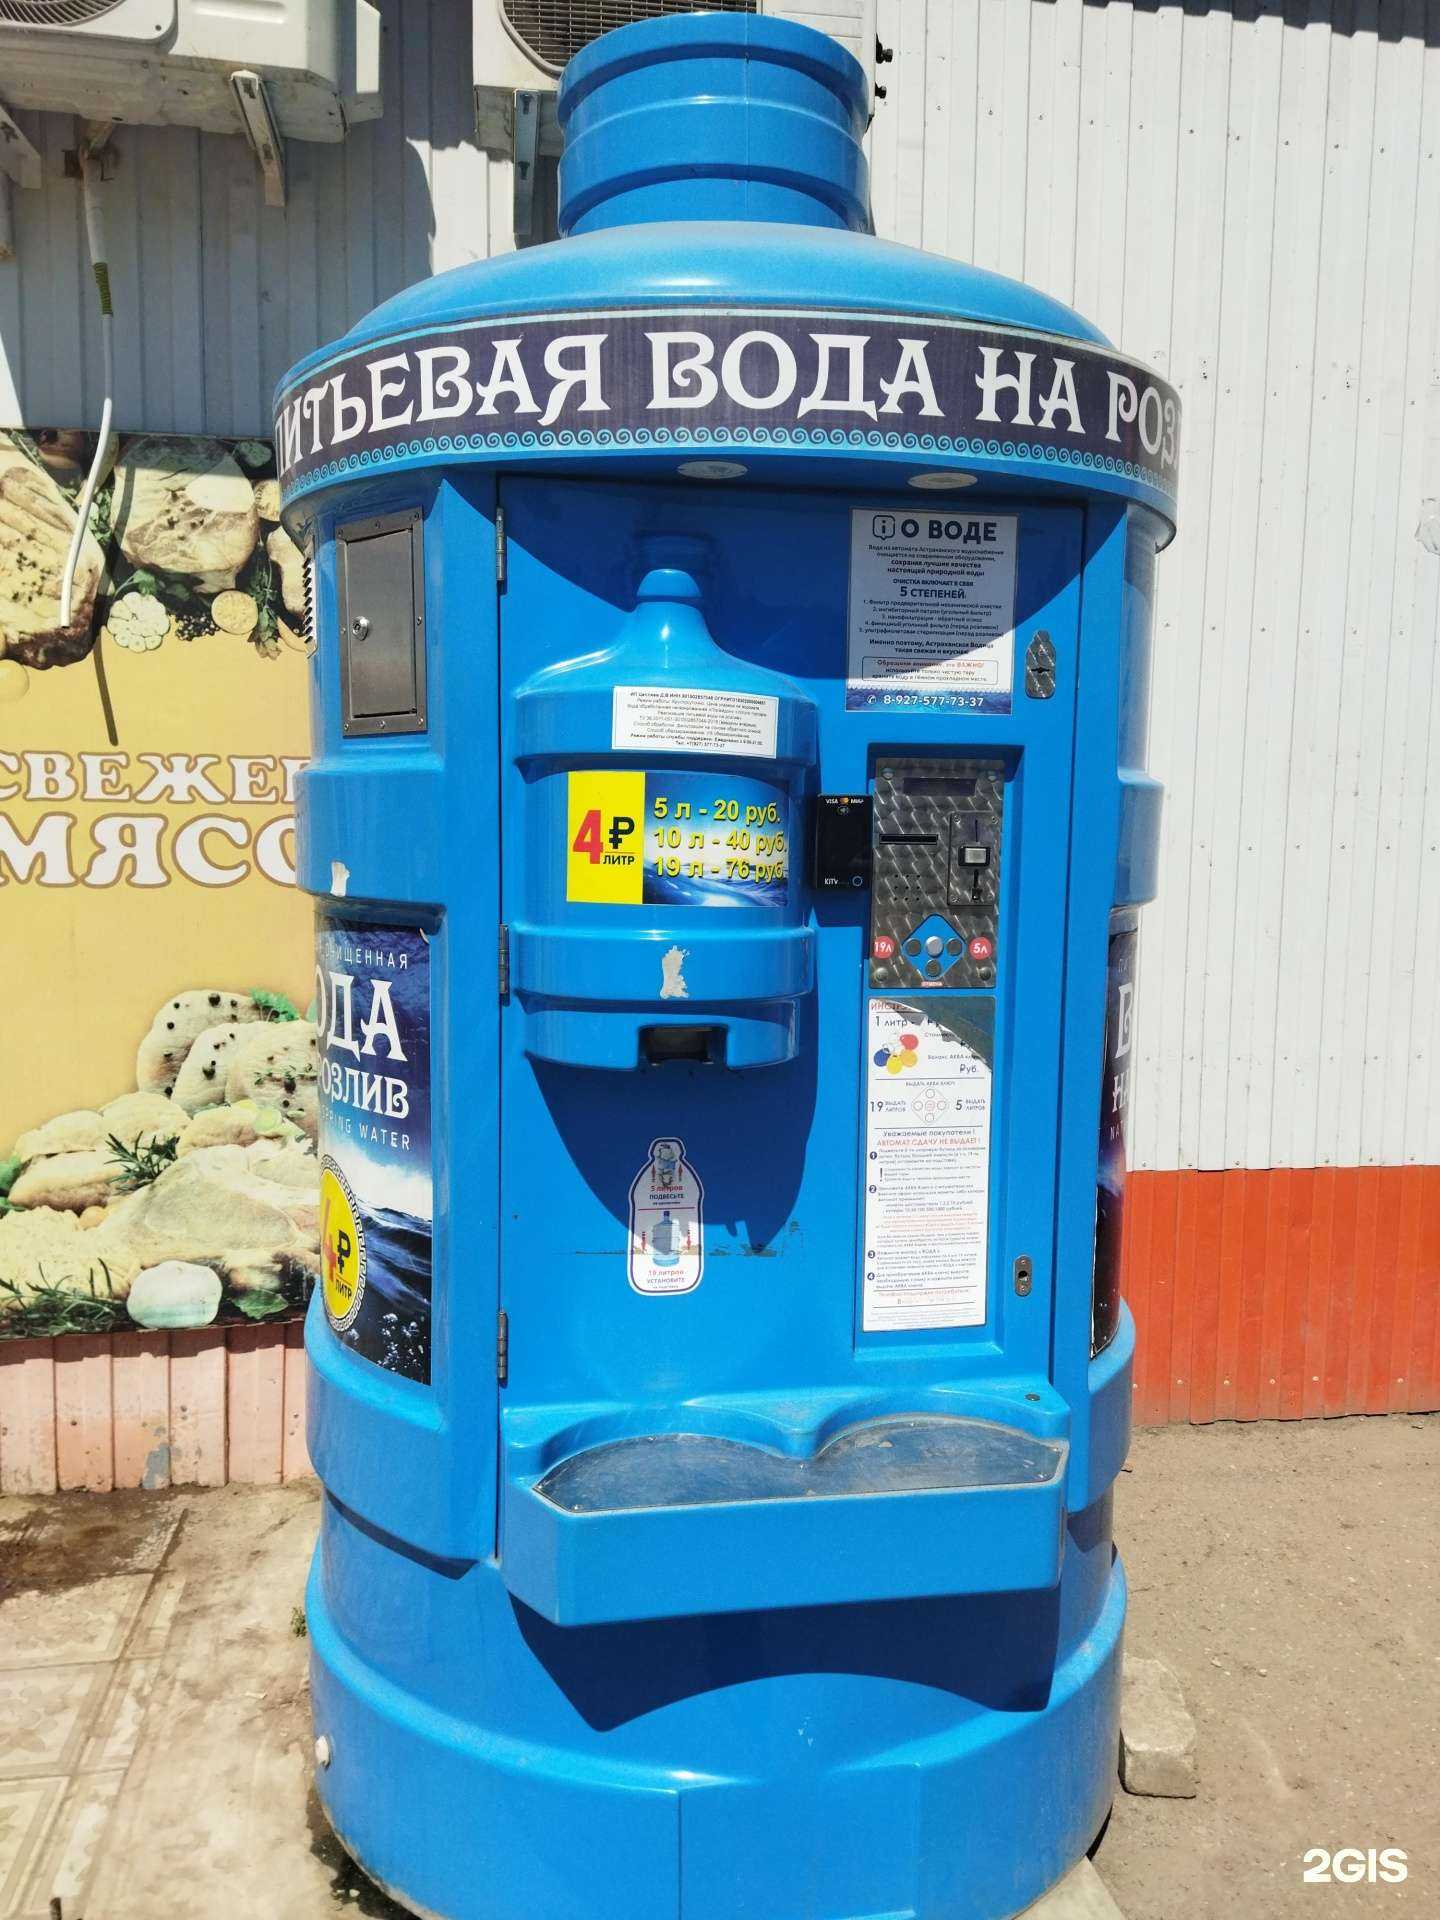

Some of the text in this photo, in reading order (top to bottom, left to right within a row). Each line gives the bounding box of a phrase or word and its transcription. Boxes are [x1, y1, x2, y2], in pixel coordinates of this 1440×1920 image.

[275, 331, 1181, 480] ПИТЬЕВАЯ ВОДА НА РОЗ
[901, 519, 997, 544] О ВОДЕ
[900, 586, 908, 598] 5
[883, 694, 984, 707] 8-927-577-73-37
[654, 797, 668, 819] 5
[674, 802, 691, 820] л
[713, 799, 740, 821] 20
[745, 802, 781, 828] руб.
[573, 809, 604, 865] 4
[654, 826, 682, 849] 10
[688, 831, 704, 849] л
[726, 831, 751, 851] 40
[755, 831, 787, 857] руб.
[603, 854, 635, 866] ЛИТР
[654, 856, 681, 878] 19
[688, 861, 704, 879] л
[726, 858, 751, 880] 76
[316, 965, 408, 1062] ОДА
[875, 1015, 908, 1029] 1 литр
[319, 1054, 409, 1120] ОЗЛИВ
[870, 1101, 884, 1113] 19
[955, 1099, 963, 1111] 5
[359, 1122, 410, 1151] WATER
[877, 1138, 910, 1147] АВТОМАТ
[911, 1137, 938, 1146] СДАЧУ
[335, 1280, 352, 1300] ЛИТР
